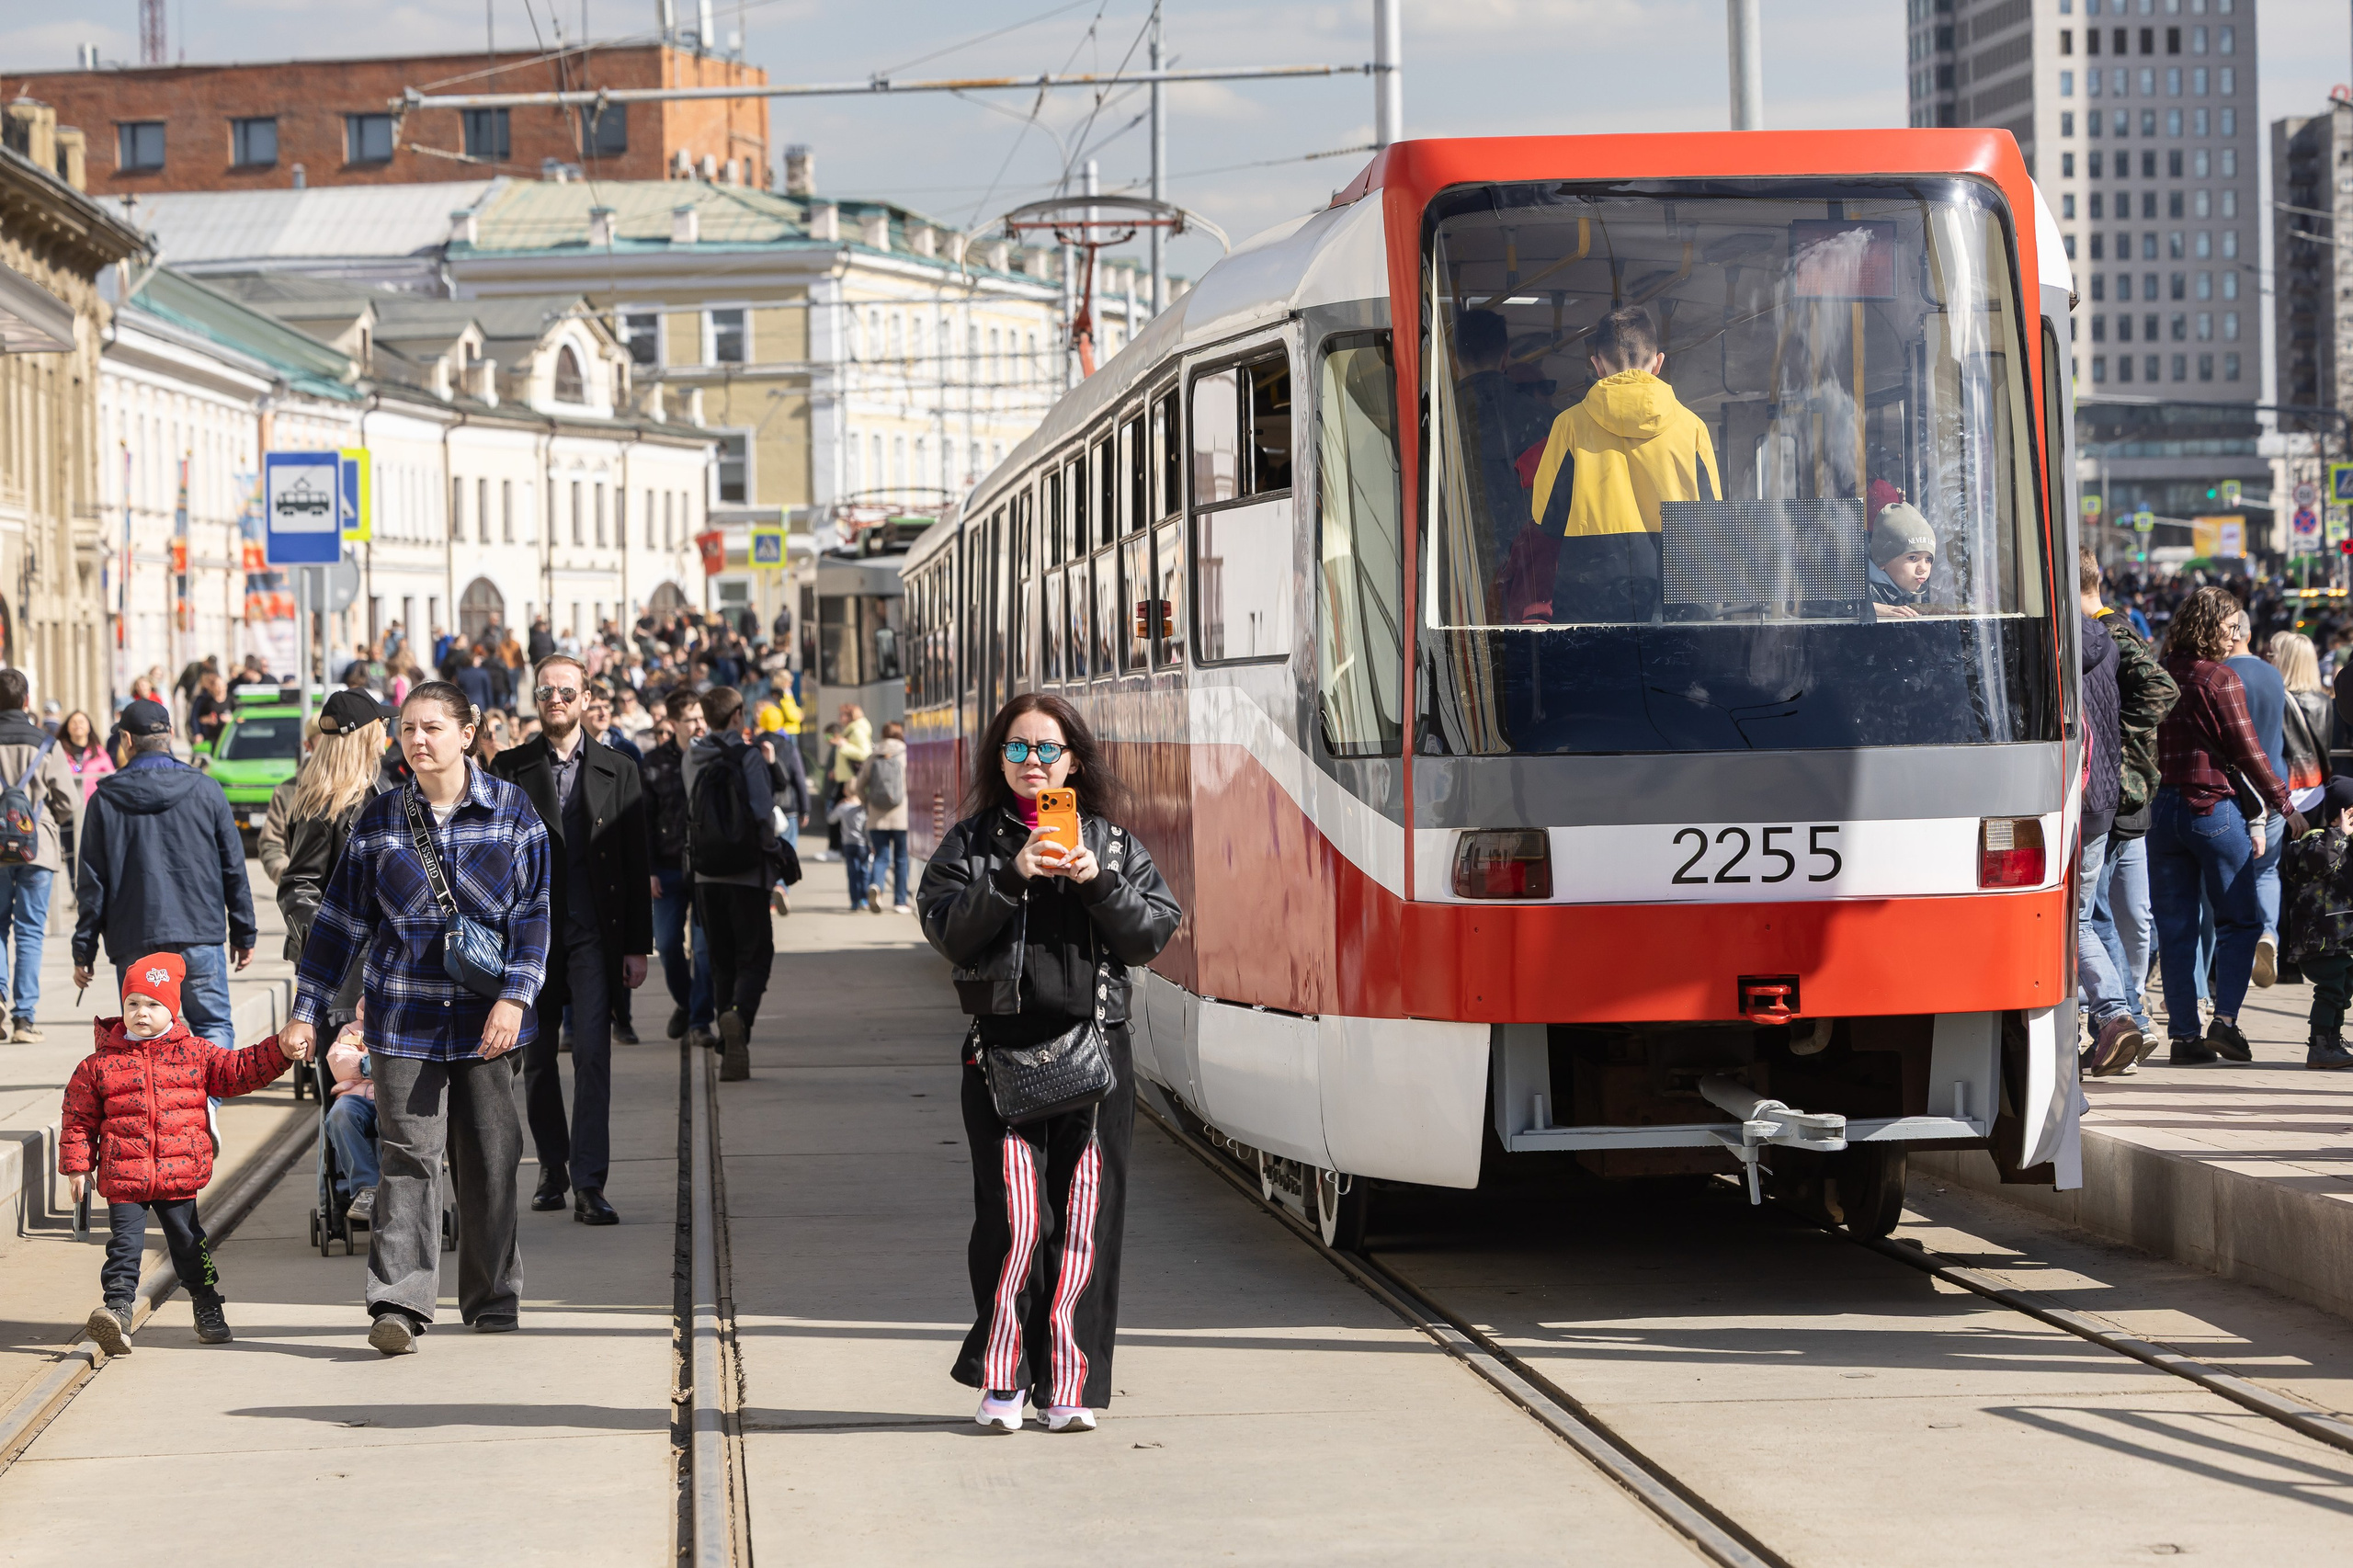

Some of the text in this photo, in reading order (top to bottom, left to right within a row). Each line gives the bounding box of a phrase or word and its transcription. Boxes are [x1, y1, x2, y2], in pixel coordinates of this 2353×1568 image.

[1907, 536, 1927, 545] NEVER
[421, 846, 439, 879] GUESS
[1671, 825, 1843, 884] 2255
